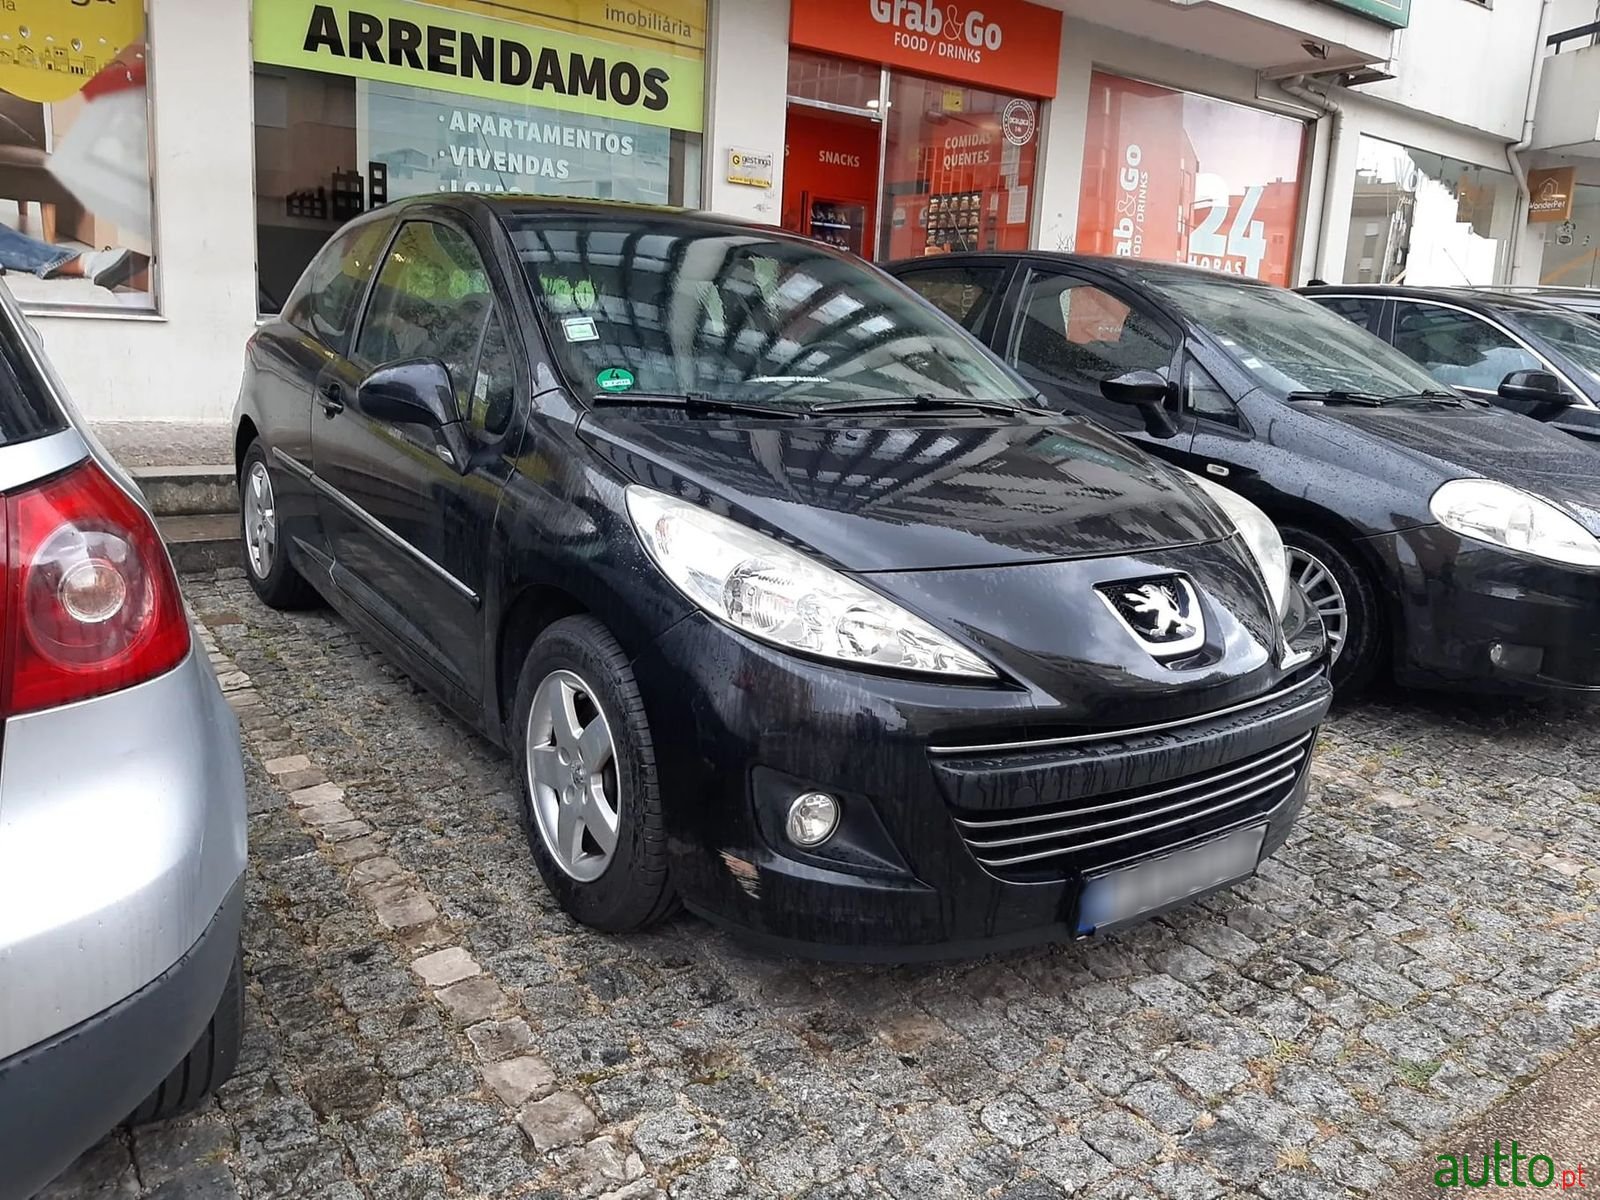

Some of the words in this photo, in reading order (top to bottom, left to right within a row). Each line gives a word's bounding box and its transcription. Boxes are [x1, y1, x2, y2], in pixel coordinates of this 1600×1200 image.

[605, 3, 692, 38] imobiliária
[303, 5, 669, 111] ARRENDAMOS
[894, 32, 928, 52] FOOD
[938, 42, 981, 63] DRINKS
[449, 110, 633, 155] APARTAMENTOS
[944, 133, 991, 149] COMIDAS
[449, 144, 569, 178] VIVENDAS
[819, 150, 860, 168] SNACKS
[943, 150, 989, 170] QUENTES
[1112, 144, 1141, 257] ab&Go
[1136, 171, 1148, 222] DRINKS
[1189, 173, 1267, 279] 24
